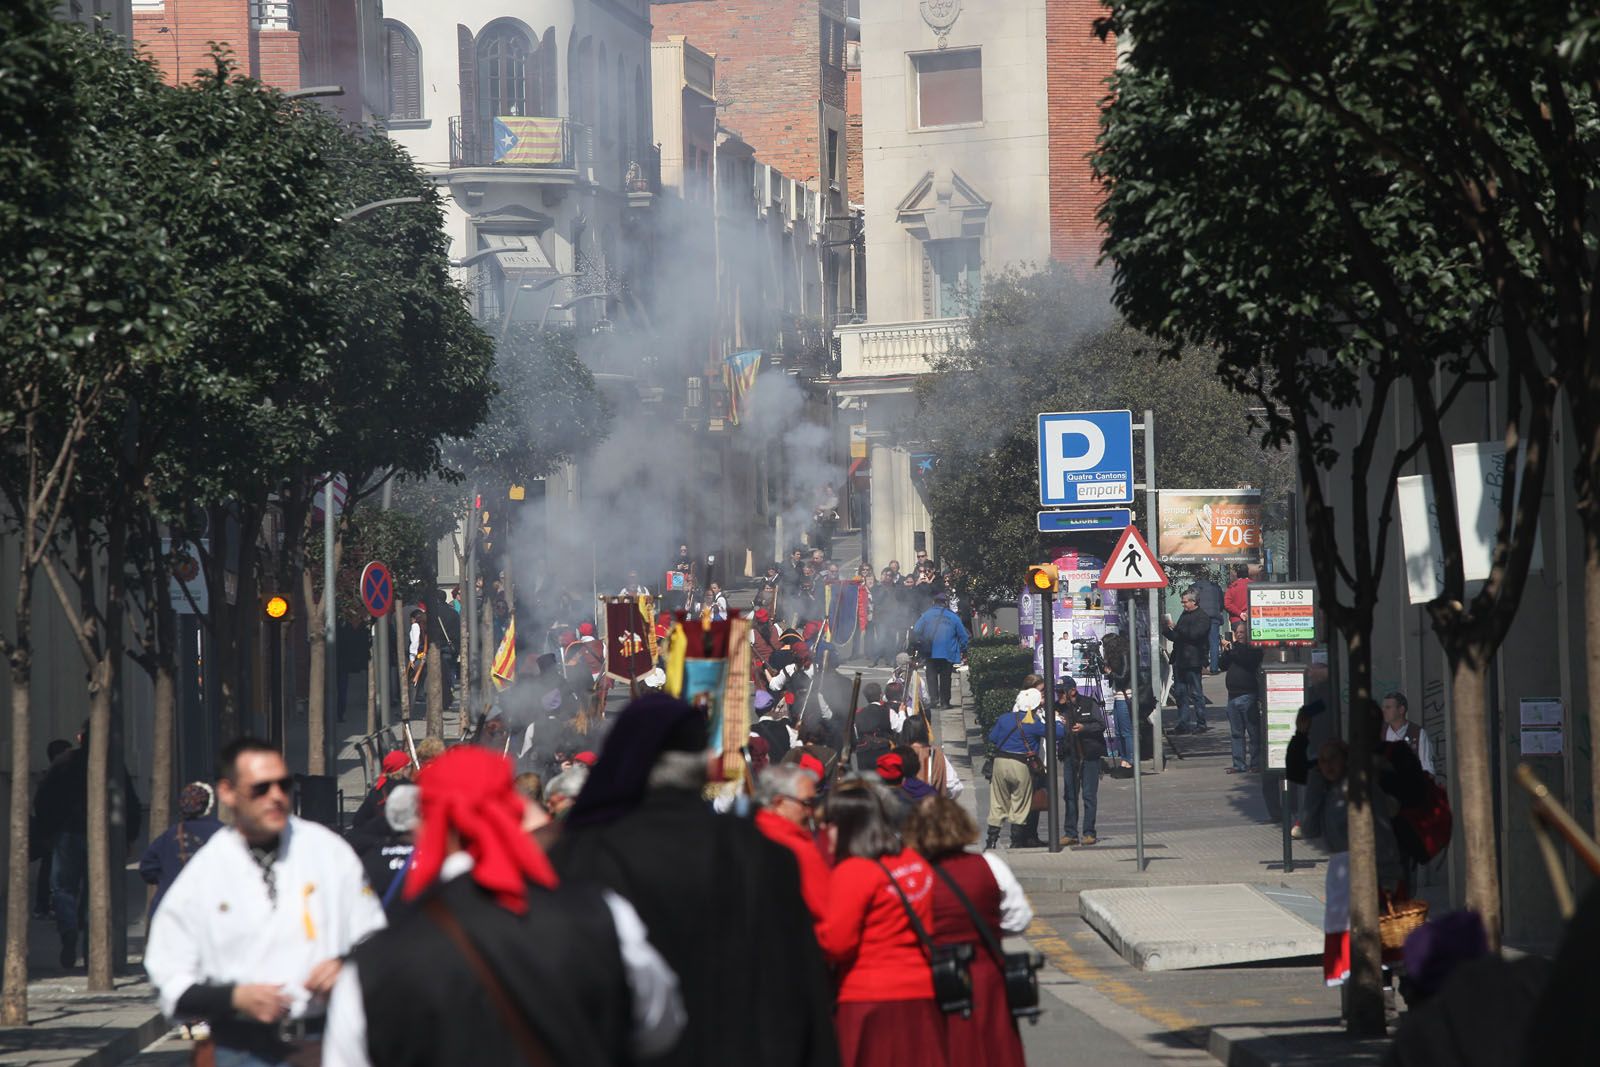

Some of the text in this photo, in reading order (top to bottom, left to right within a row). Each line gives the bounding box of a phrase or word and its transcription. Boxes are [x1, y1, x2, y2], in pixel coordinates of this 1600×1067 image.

[1045, 419, 1106, 499] P
[1078, 484, 1125, 498] empark
[1216, 517, 1232, 525] 160
[1215, 526, 1255, 545] 70€
[1280, 590, 1304, 600] BUS
